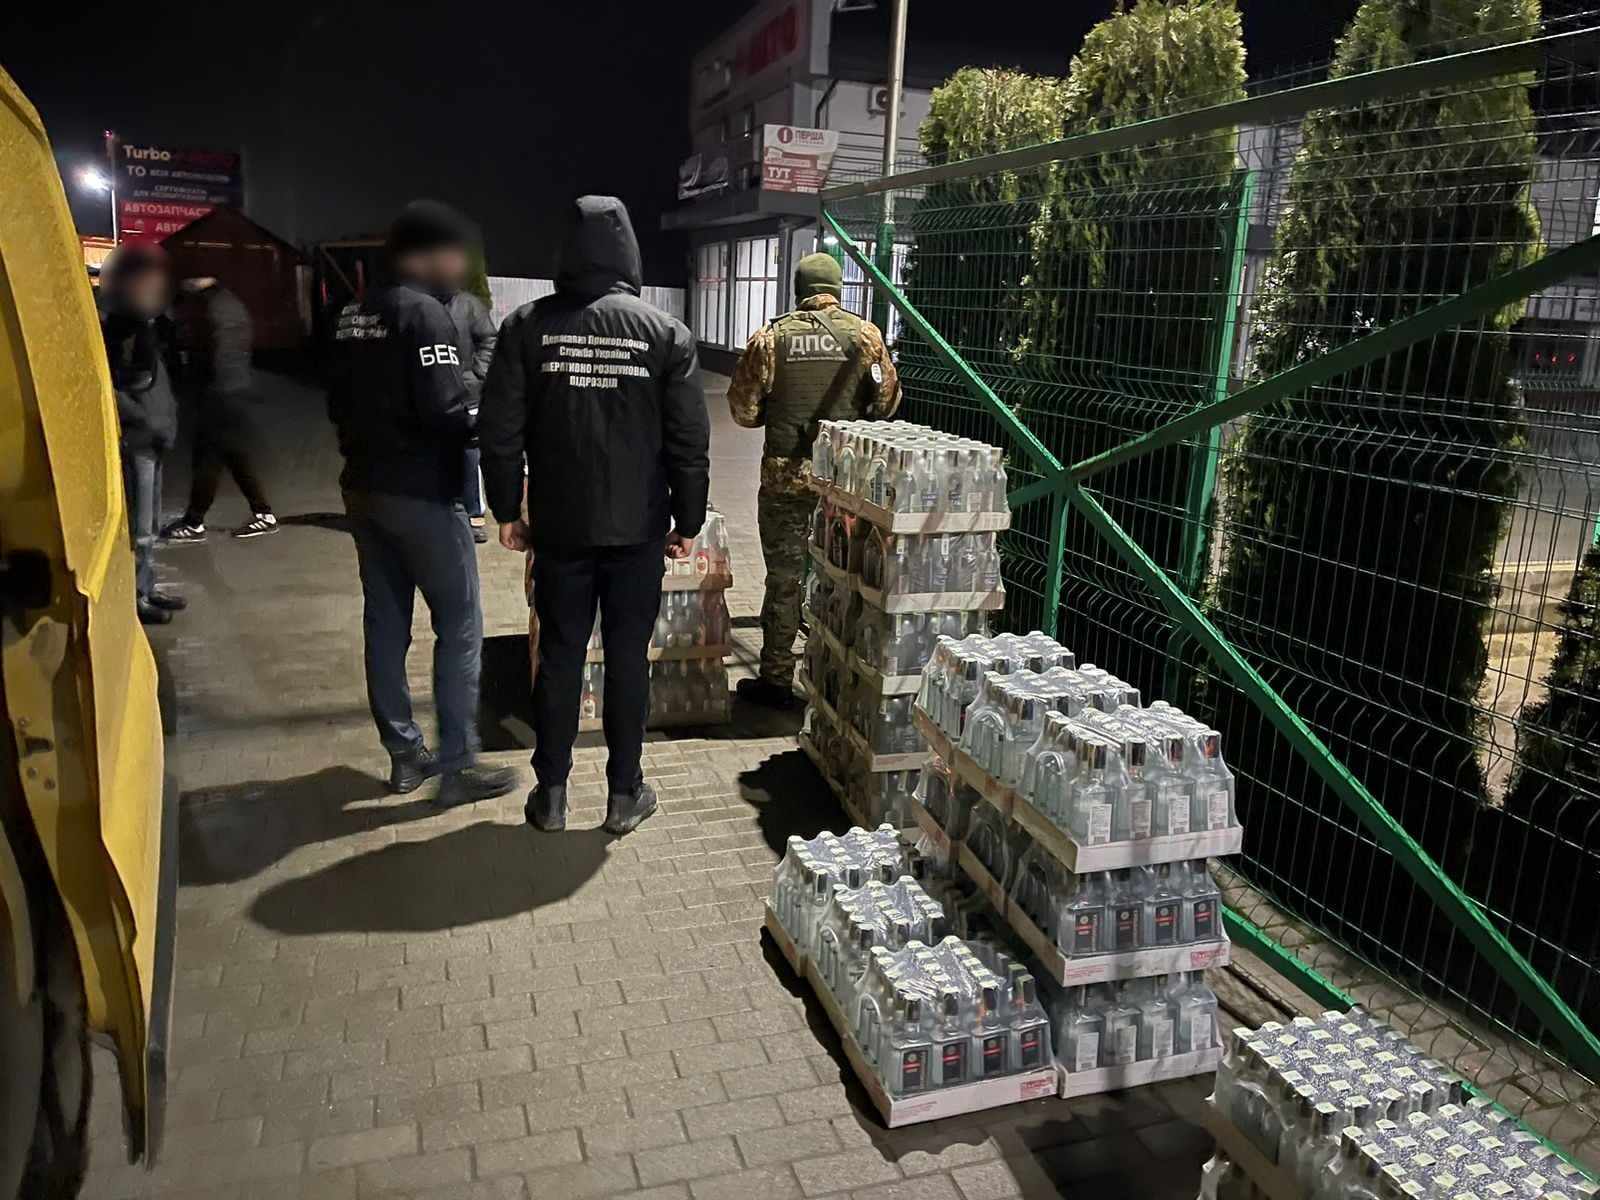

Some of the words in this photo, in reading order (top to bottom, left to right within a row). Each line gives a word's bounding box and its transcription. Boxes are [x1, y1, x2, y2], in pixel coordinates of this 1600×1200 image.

[123, 145, 171, 161] Turbo
[768, 166, 792, 179] ТУТ
[790, 334, 842, 356] ДПС
[419, 344, 459, 367] БЕБ
[559, 346, 594, 358] Служба
[594, 348, 631, 360] України
[570, 375, 618, 388] ПІДРОЗДІЛ
